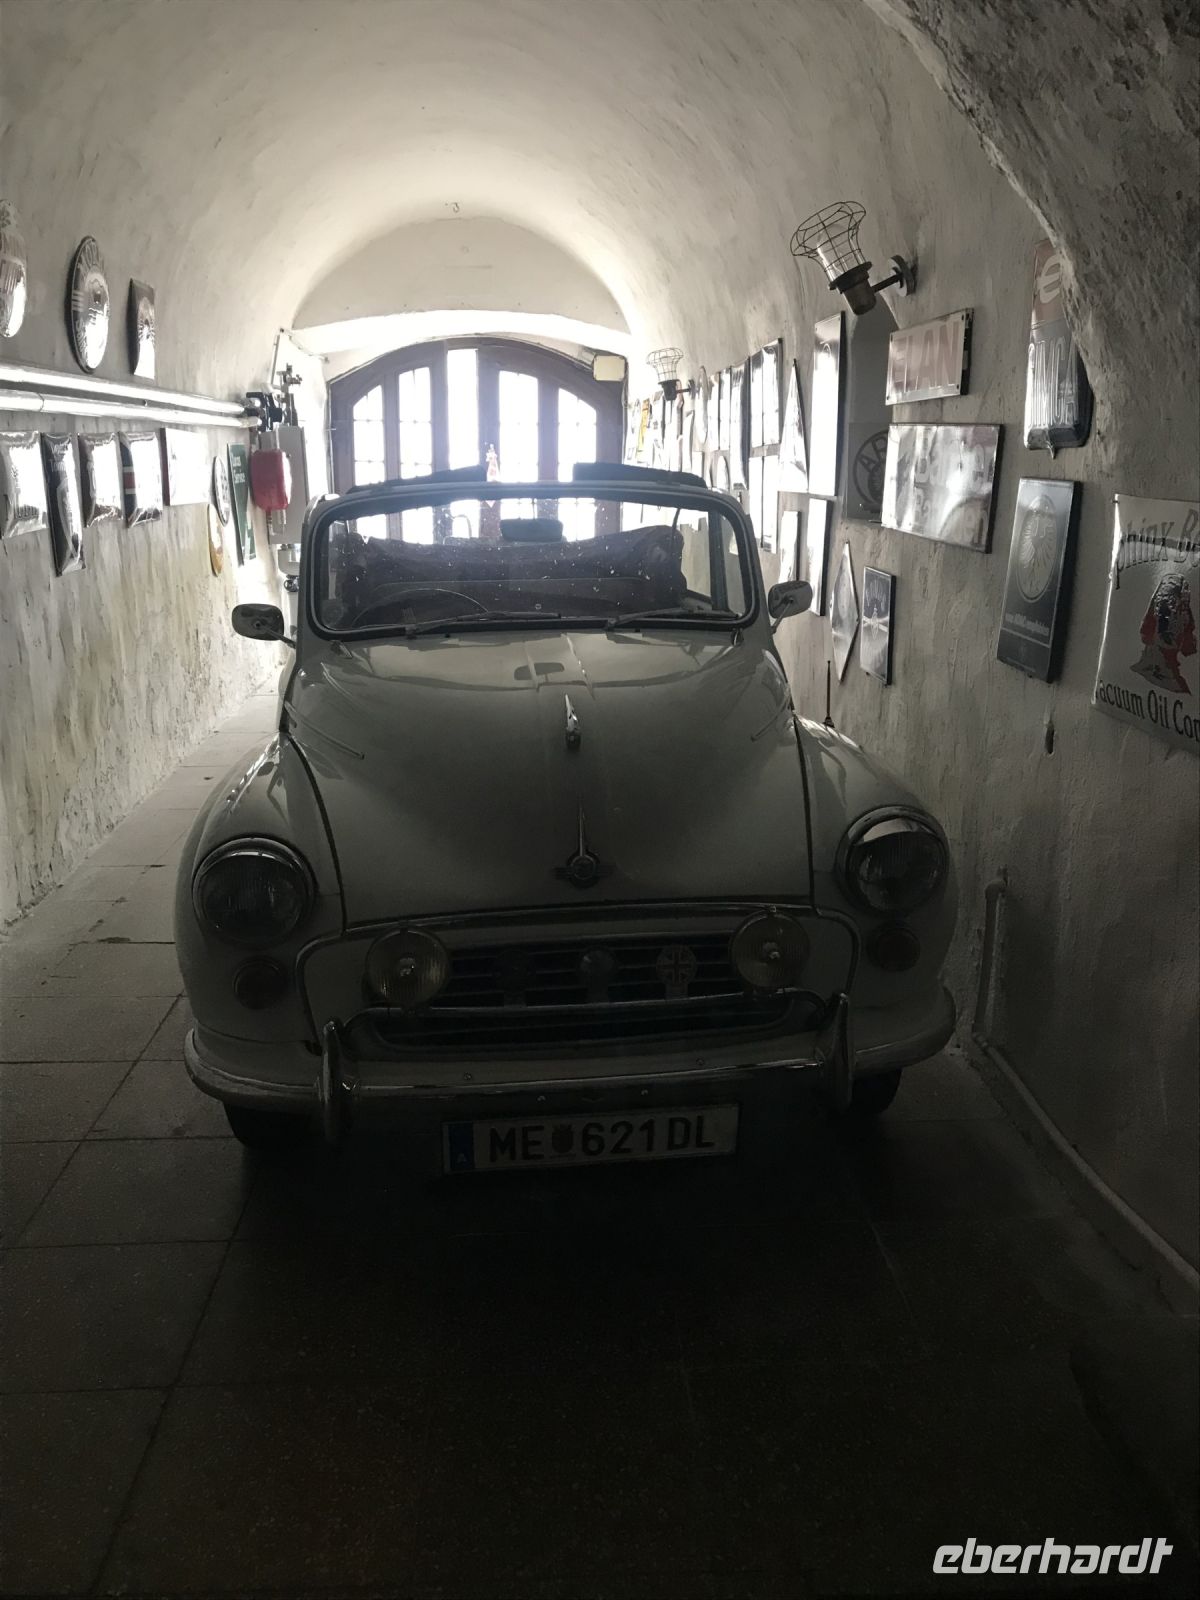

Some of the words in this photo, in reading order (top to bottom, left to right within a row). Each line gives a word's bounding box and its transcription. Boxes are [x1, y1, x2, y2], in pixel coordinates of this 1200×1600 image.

[1115, 517, 1175, 590] phinx
[1096, 680, 1145, 720] acuum
[1148, 691, 1170, 729] Oil
